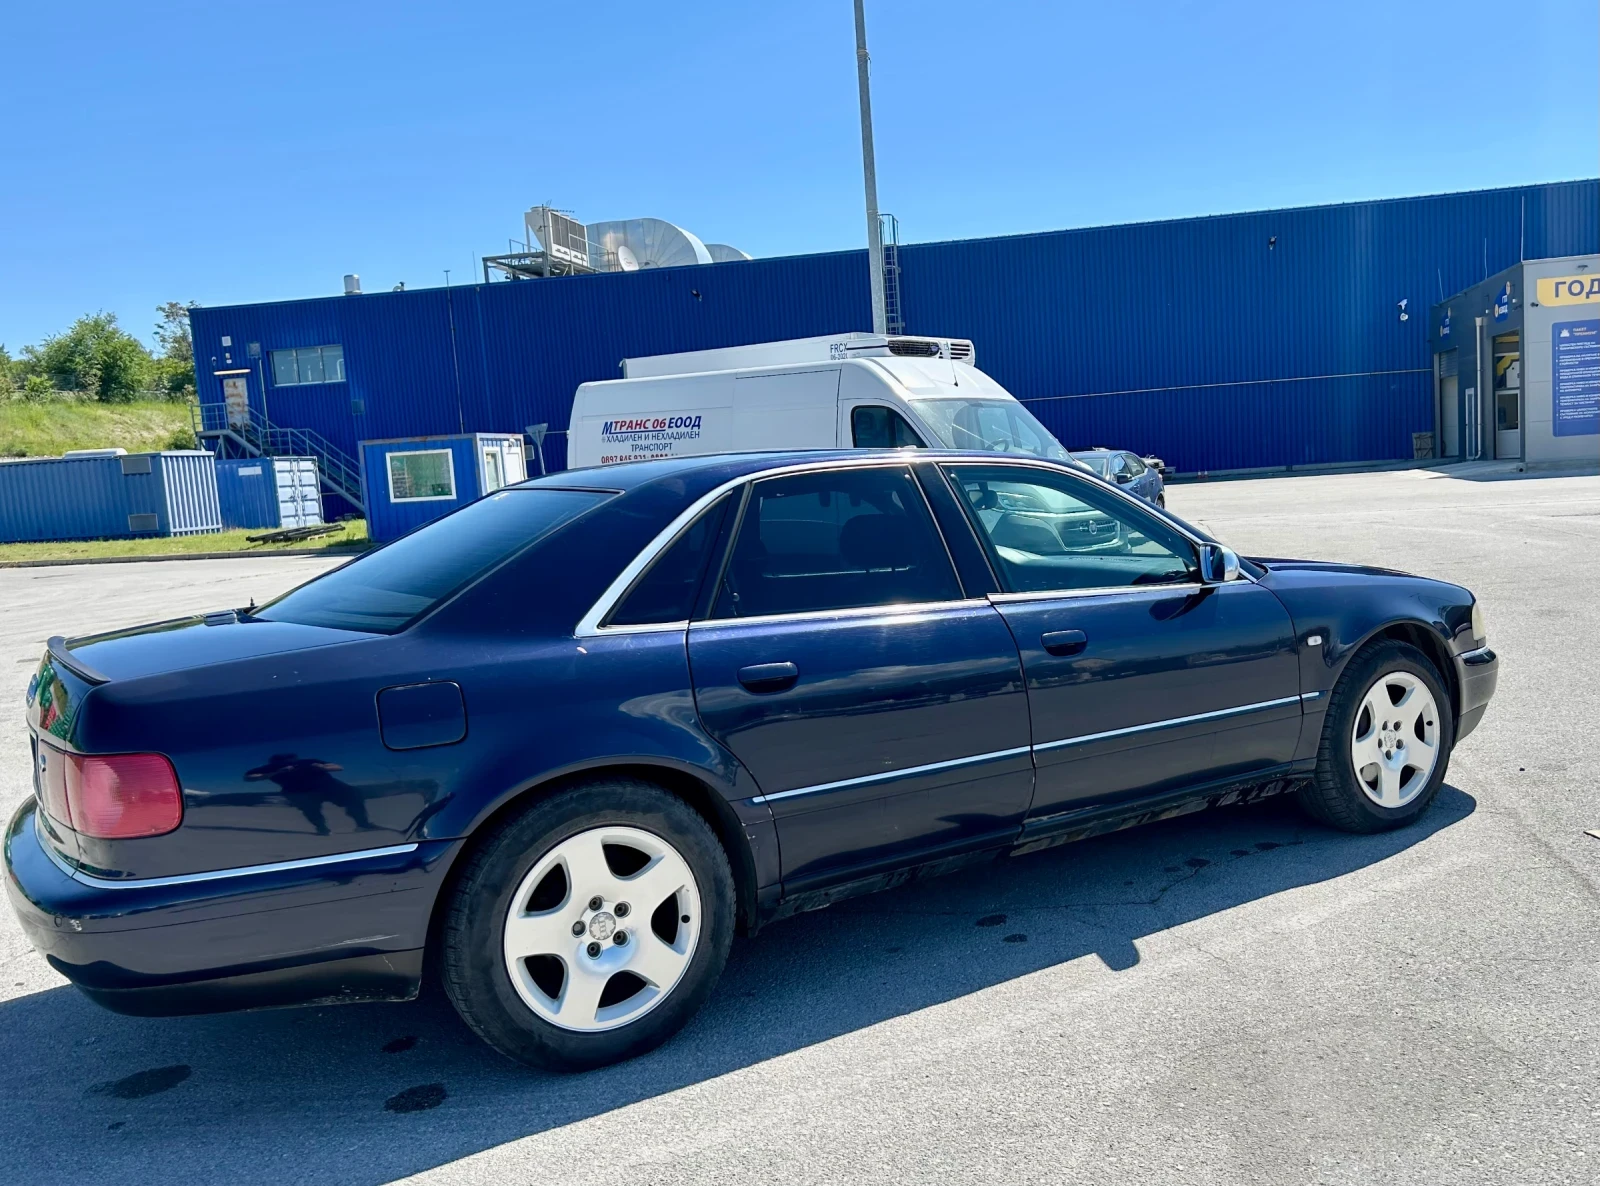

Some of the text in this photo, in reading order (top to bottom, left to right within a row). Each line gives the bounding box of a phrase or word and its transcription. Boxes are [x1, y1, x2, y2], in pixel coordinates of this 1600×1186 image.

[1554, 278, 1600, 299] ГОД
[652, 418, 667, 429] 06
[667, 416, 702, 430] ЕООД
[606, 431, 700, 443] ХЛАДИЛЕН И НЕХЛАДИЛЕН
[631, 442, 673, 452] ТРАНСПОРТ
